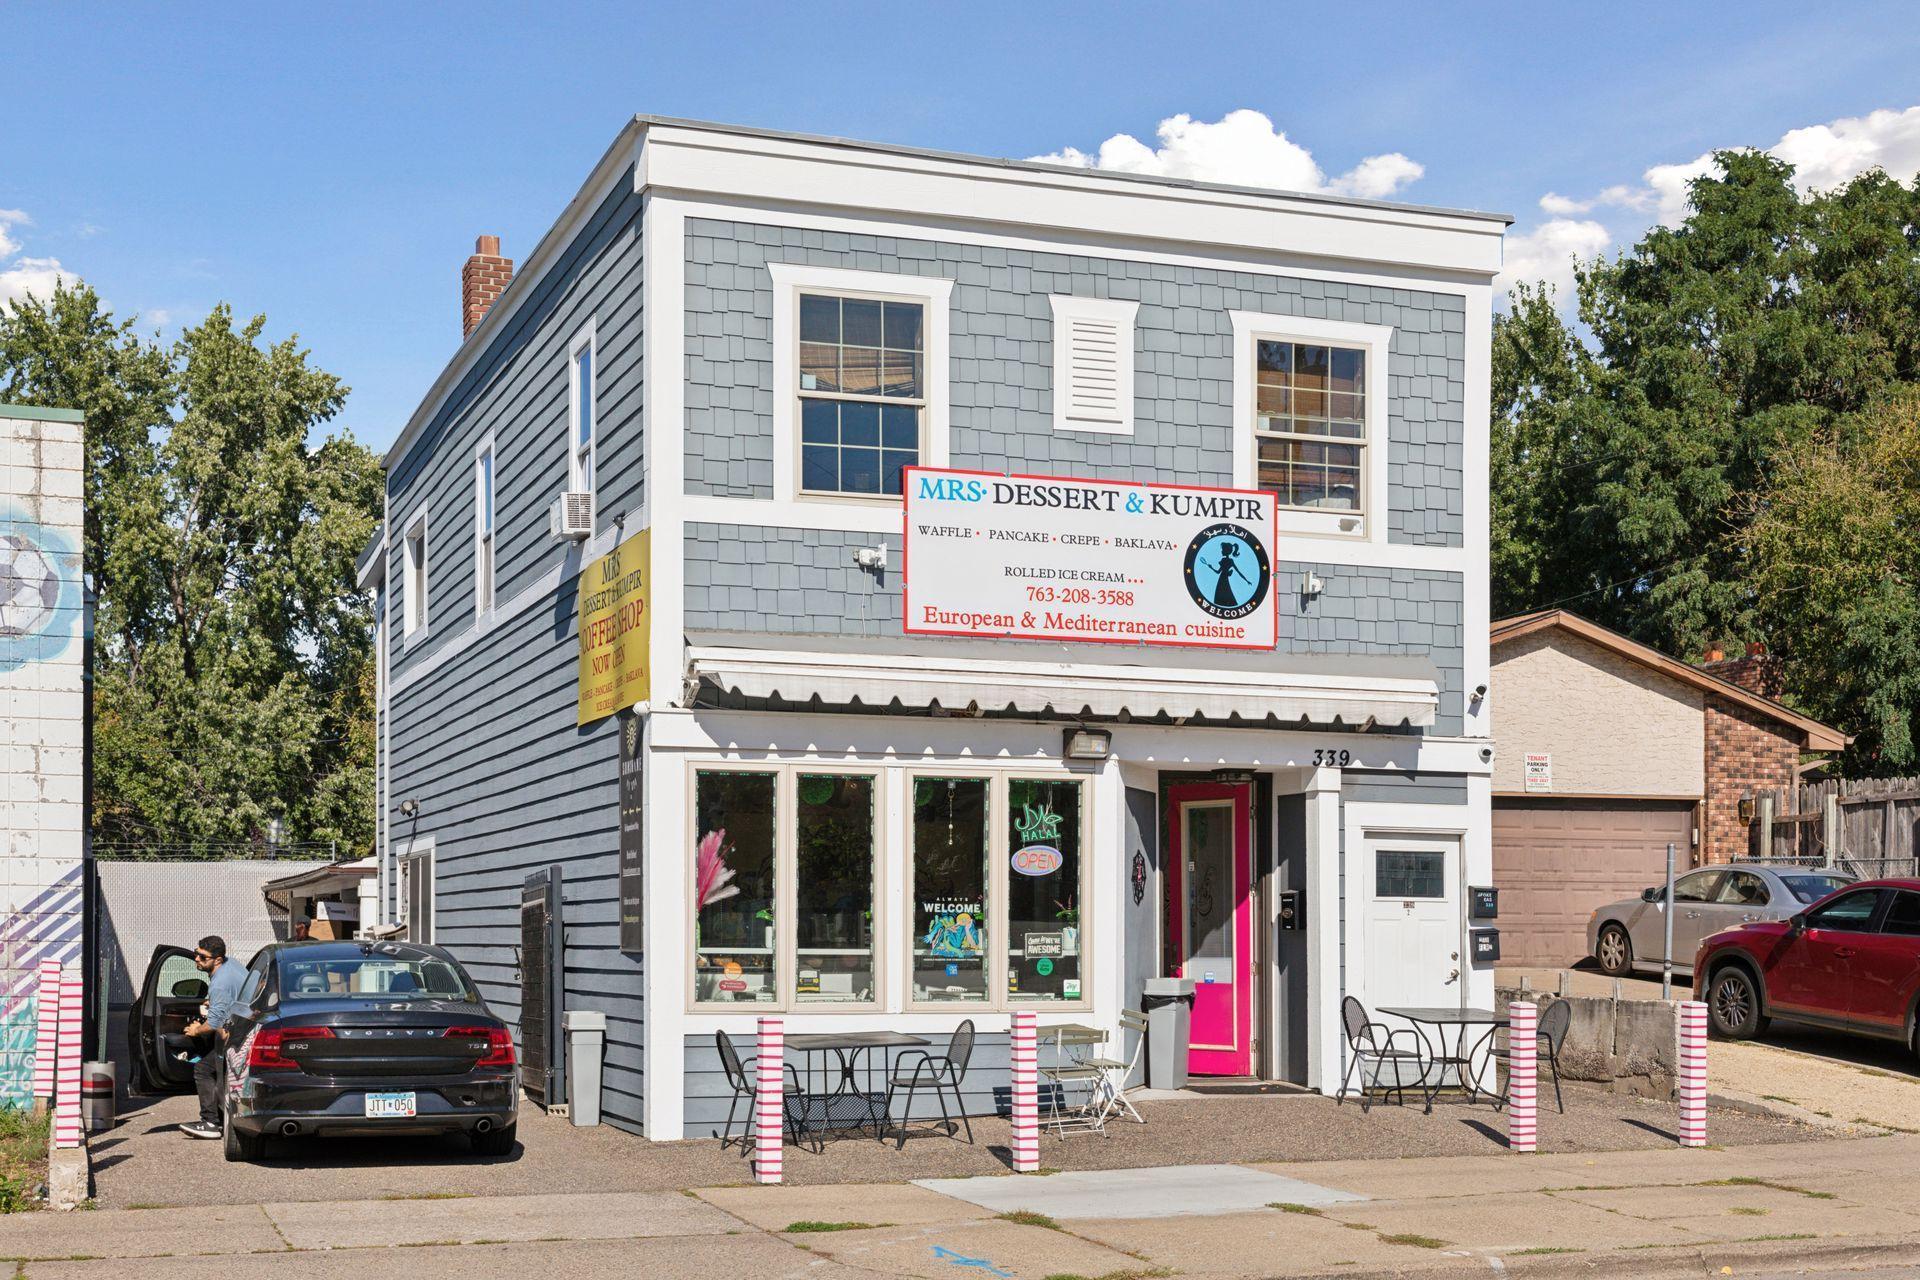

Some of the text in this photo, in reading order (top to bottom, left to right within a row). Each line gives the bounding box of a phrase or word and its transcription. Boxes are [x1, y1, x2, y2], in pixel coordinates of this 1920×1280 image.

[992, 482, 1120, 512] DESSERT
[1125, 492, 1144, 514] &
[1150, 493, 1264, 521] KUMPIR
[918, 525, 1173, 551] WAFFLE PANCAKE CREPE BAKLAVA
[1004, 566, 1056, 579] ROLLED
[1059, 569, 1078, 580] ICE
[1026, 586, 1134, 606] 763-208-3588
[1201, 599, 1253, 619] WELCOME
[923, 606, 1245, 639] European & Mediterranean cuisine
[592, 653, 611, 676] NOW
[1312, 749, 1350, 767] 339
[1022, 829, 1062, 841] HALAL
[1017, 851, 1057, 869] OPEN
[923, 903, 981, 913] WELCOME
[1028, 945, 1061, 954] AWESOME
[369, 1098, 413, 1111] JTT 050
